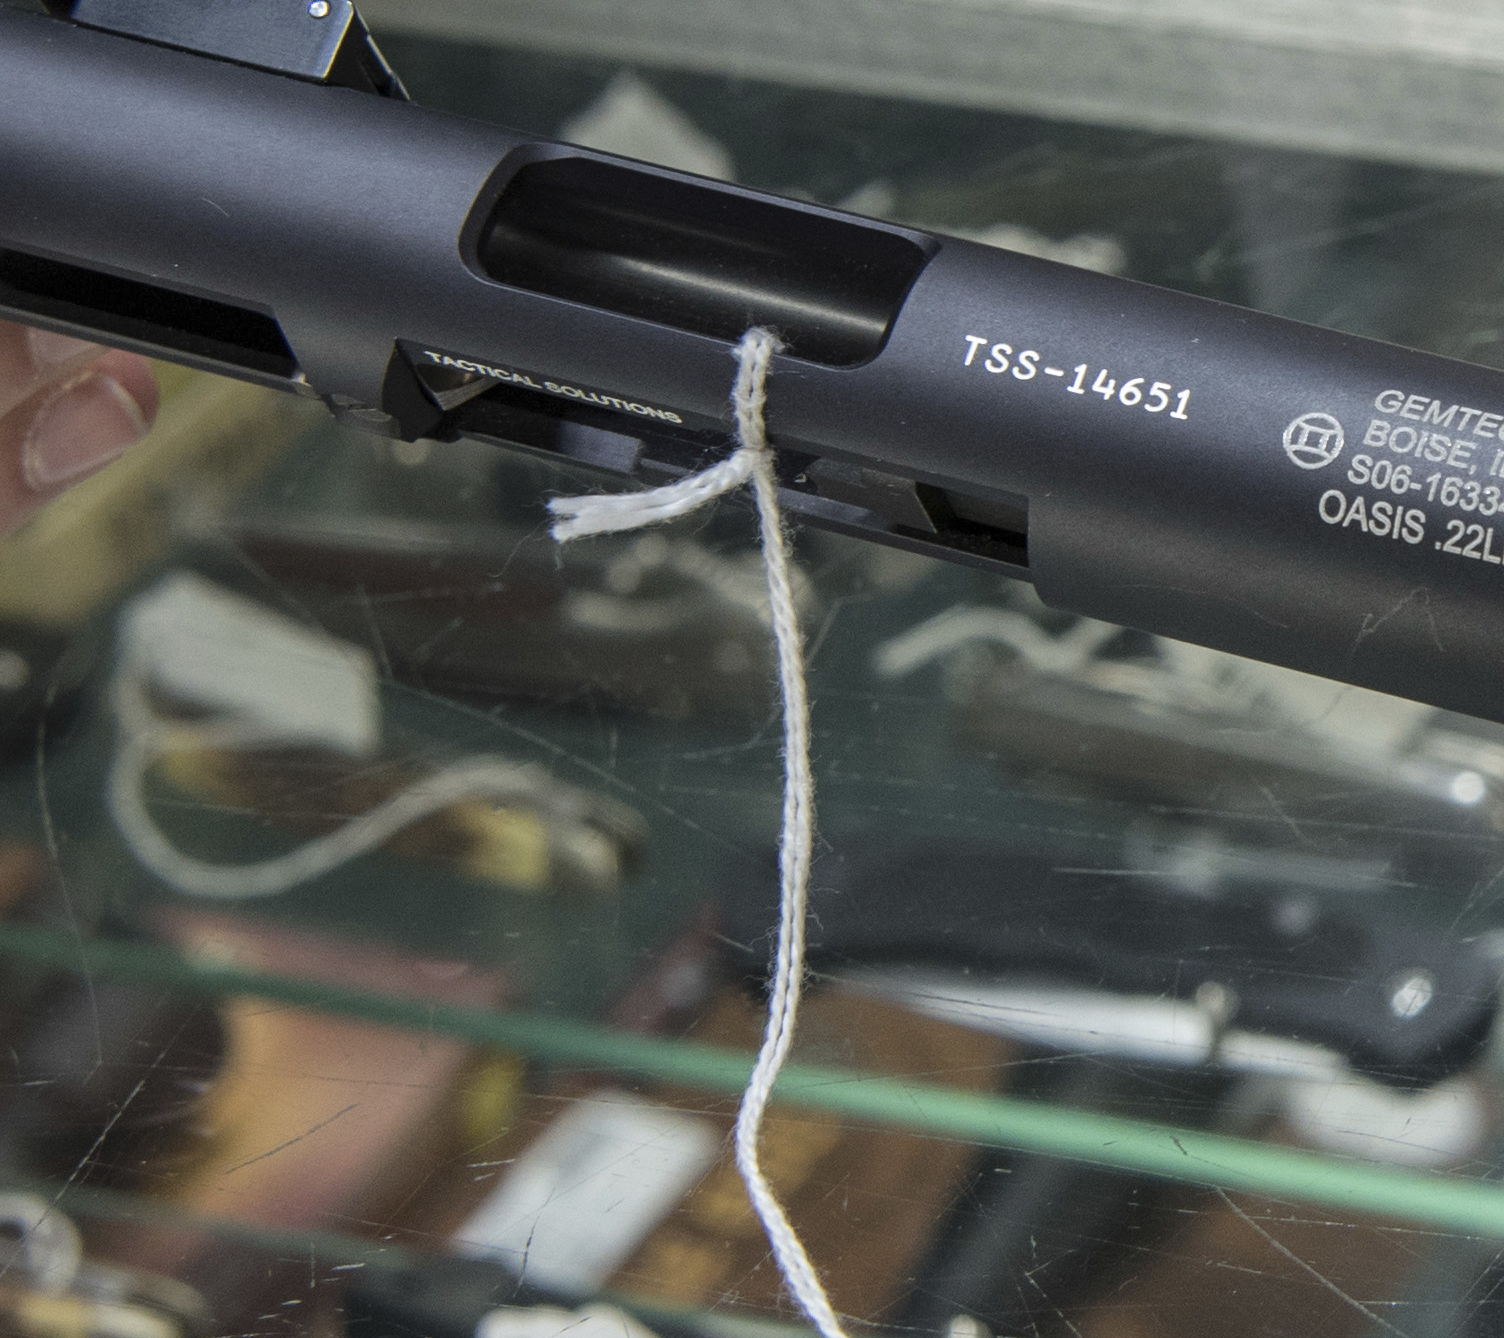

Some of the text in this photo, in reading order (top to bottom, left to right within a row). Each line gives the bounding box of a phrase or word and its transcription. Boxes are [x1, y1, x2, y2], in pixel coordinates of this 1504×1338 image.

[424, 350, 682, 424] TACTICAL SOLUTIONS
[964, 334, 1190, 420] TSS-14651
[1363, 419, 1477, 475] BOISE,
[1318, 489, 1426, 544] OASIS
